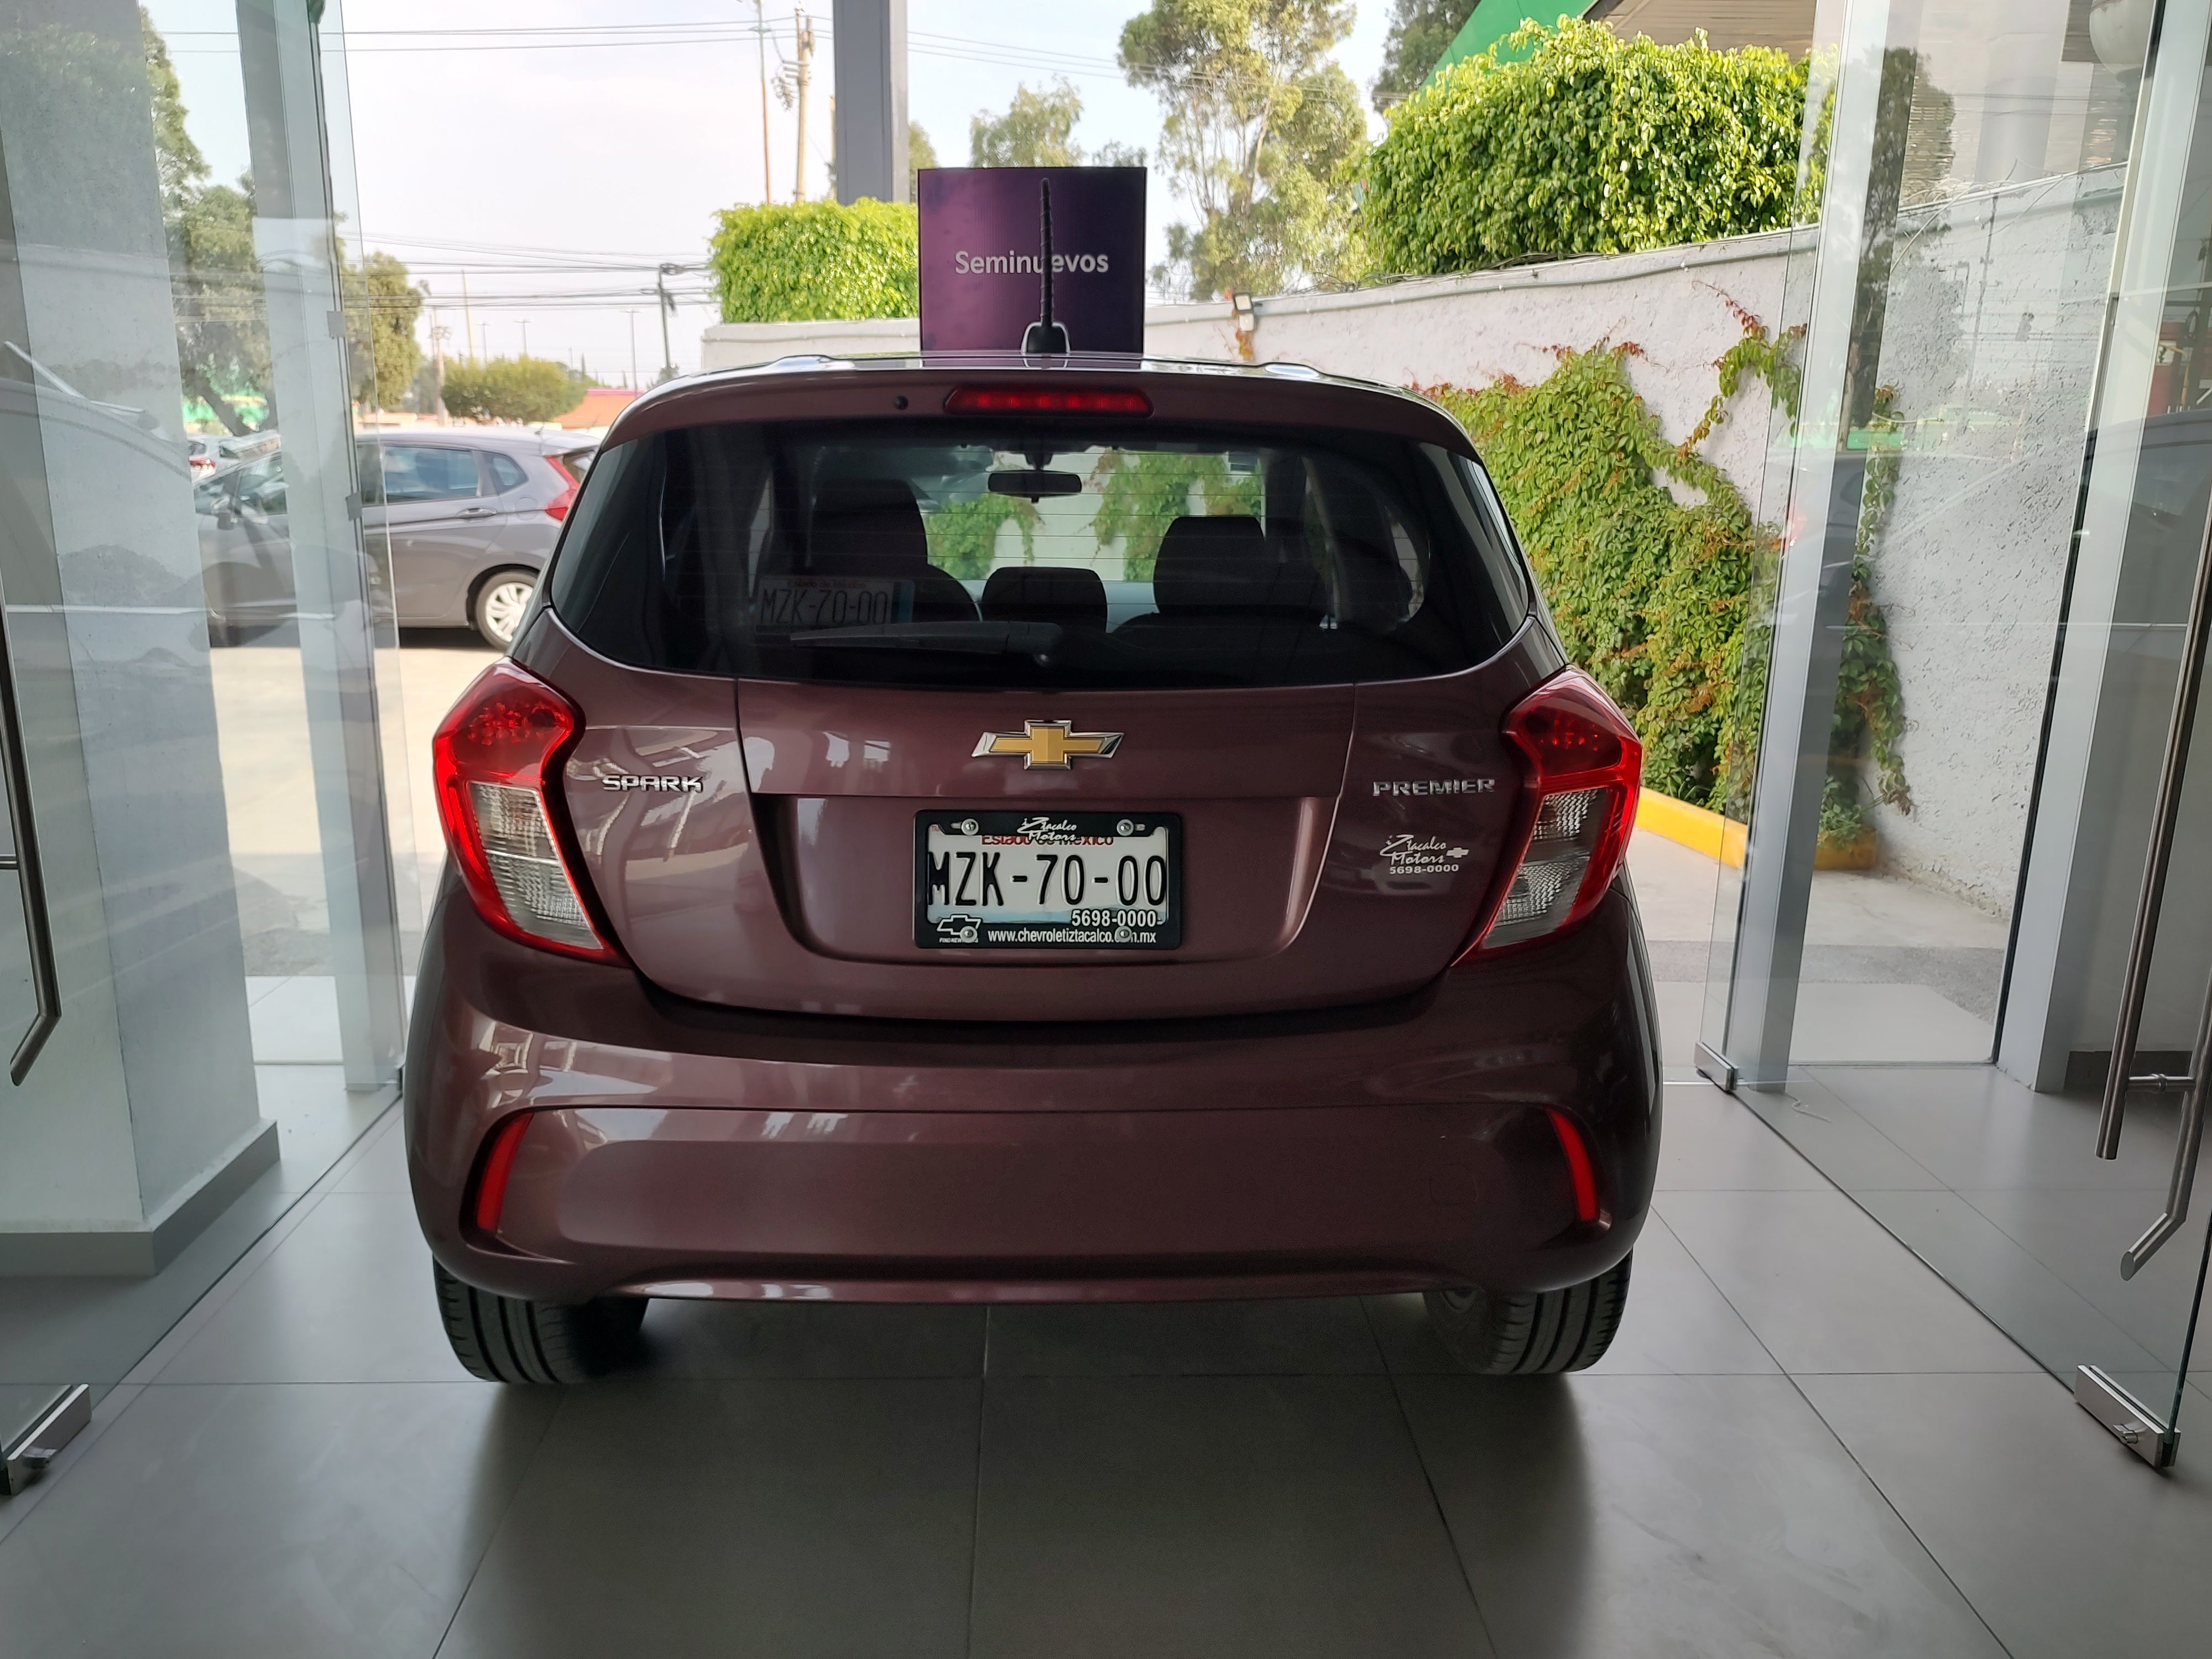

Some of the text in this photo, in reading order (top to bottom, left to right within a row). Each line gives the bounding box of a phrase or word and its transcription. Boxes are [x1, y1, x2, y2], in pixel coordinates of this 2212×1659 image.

[955, 250, 1109, 274] Seminuevos
[602, 775, 703, 792] SPARK
[1373, 779, 1495, 796] PREMIER
[1391, 852, 1444, 865] Motors
[1390, 864, 1459, 874] 5698-0000
[928, 851, 1167, 906] MZK-70-00
[1072, 910, 1157, 927] 5698-0000
[988, 927, 1156, 943] www.chevroletiztacalco.cm.mx
